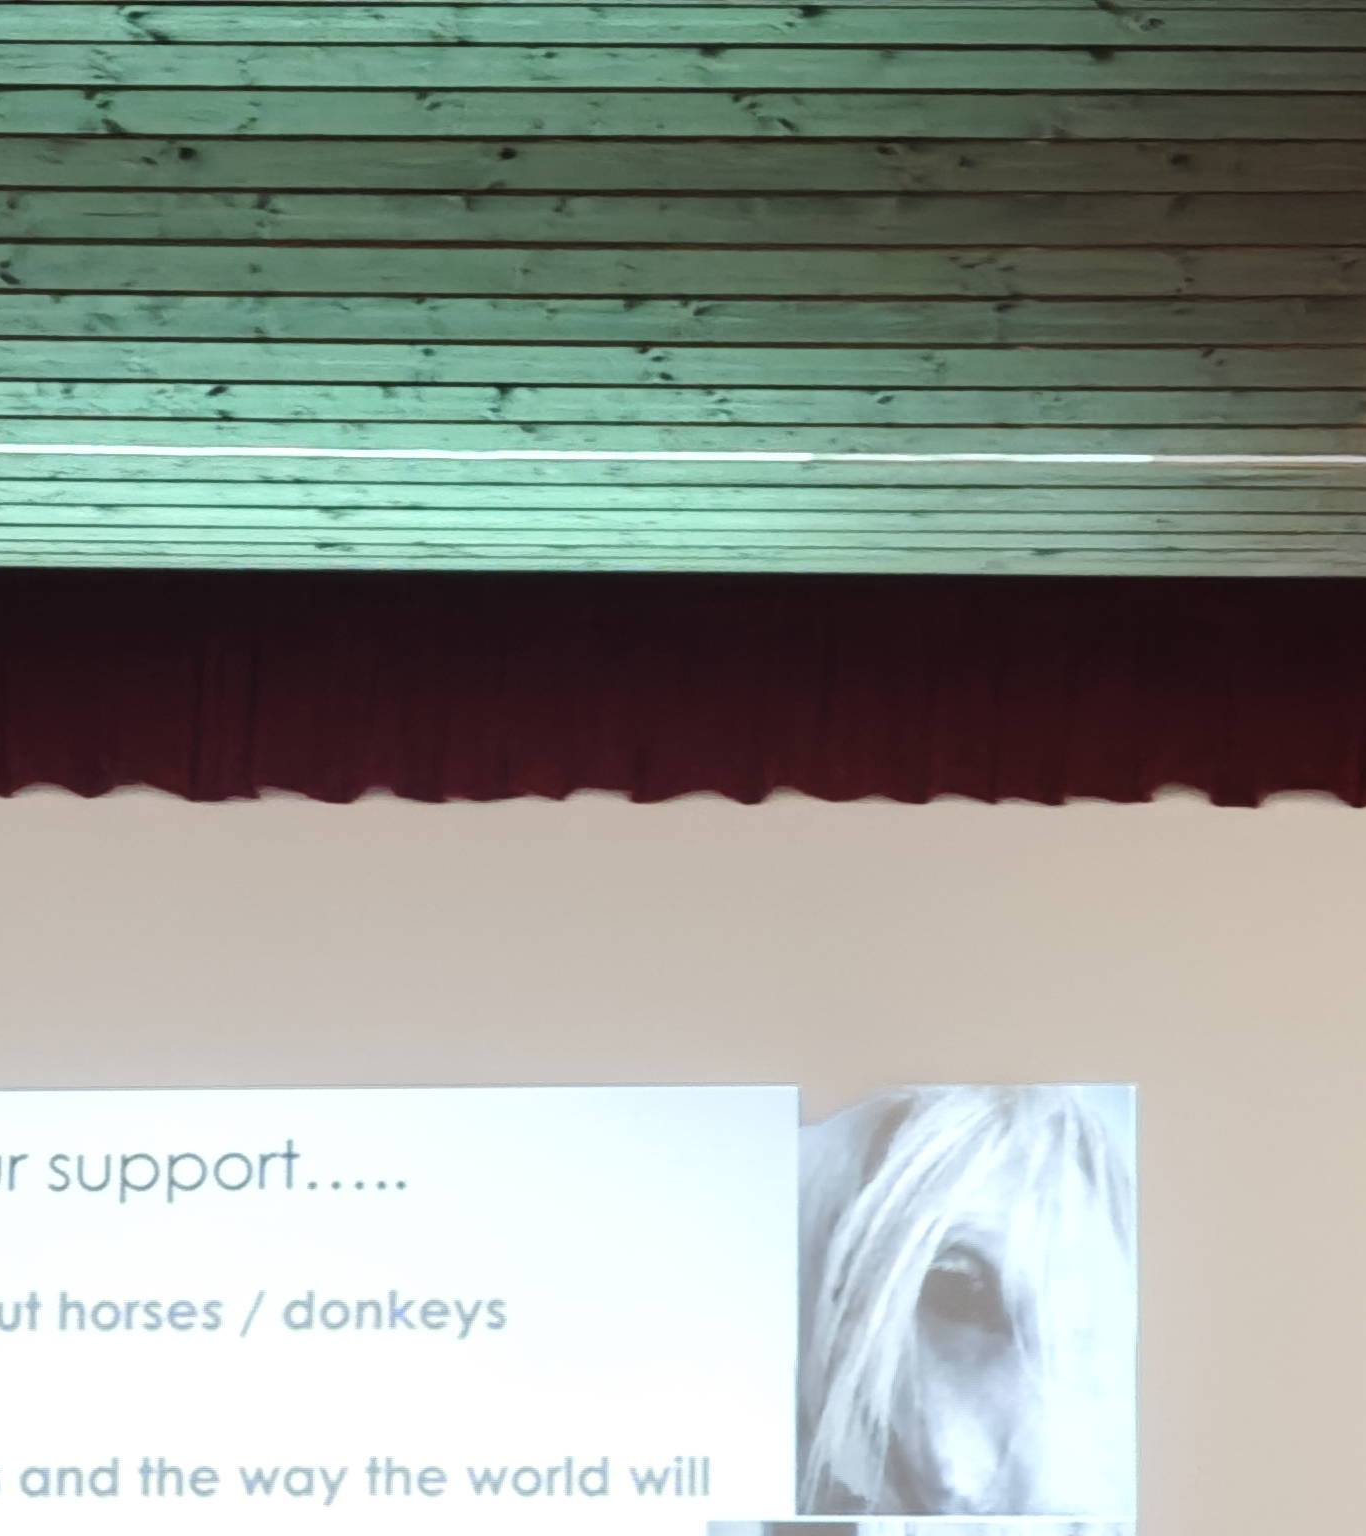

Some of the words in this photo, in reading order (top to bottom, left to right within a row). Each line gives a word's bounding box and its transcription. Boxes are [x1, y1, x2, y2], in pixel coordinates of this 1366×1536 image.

[58, 1290, 223, 1332] horses
[238, 1290, 265, 1338] /
[283, 1290, 507, 1340] donkeys
[19, 1458, 119, 1498] and
[138, 1456, 220, 1497] the
[239, 1466, 348, 1506] way
[365, 1456, 447, 1497] the
[467, 1456, 609, 1497] world
[629, 1456, 710, 1496] will
